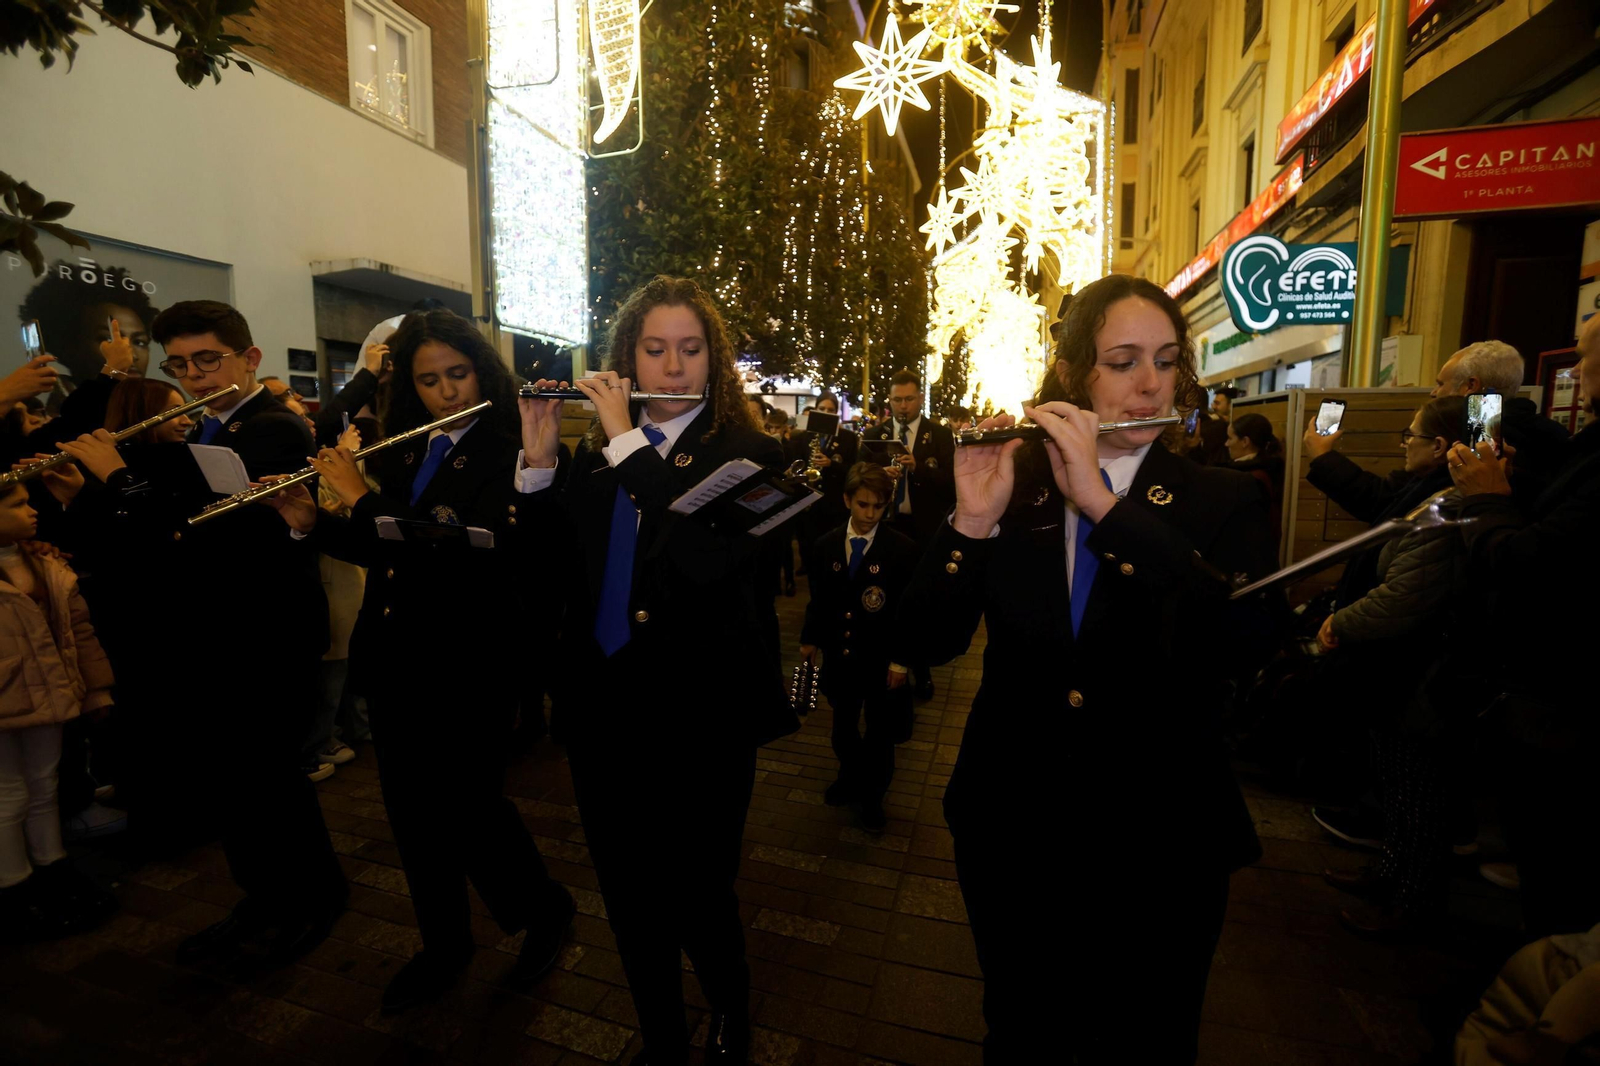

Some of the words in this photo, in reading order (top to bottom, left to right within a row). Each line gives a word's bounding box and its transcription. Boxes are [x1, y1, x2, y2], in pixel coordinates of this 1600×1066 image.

[1455, 142, 1595, 169] CAPITAN
[1453, 168, 1507, 179] ASESORES
[1510, 160, 1593, 174] INMOBILIARIOS
[1478, 185, 1535, 197] PLANTA
[1304, 292, 1313, 301] de
[1314, 291, 1332, 301] Salud
[1295, 302, 1341, 310] www.efeta.es
